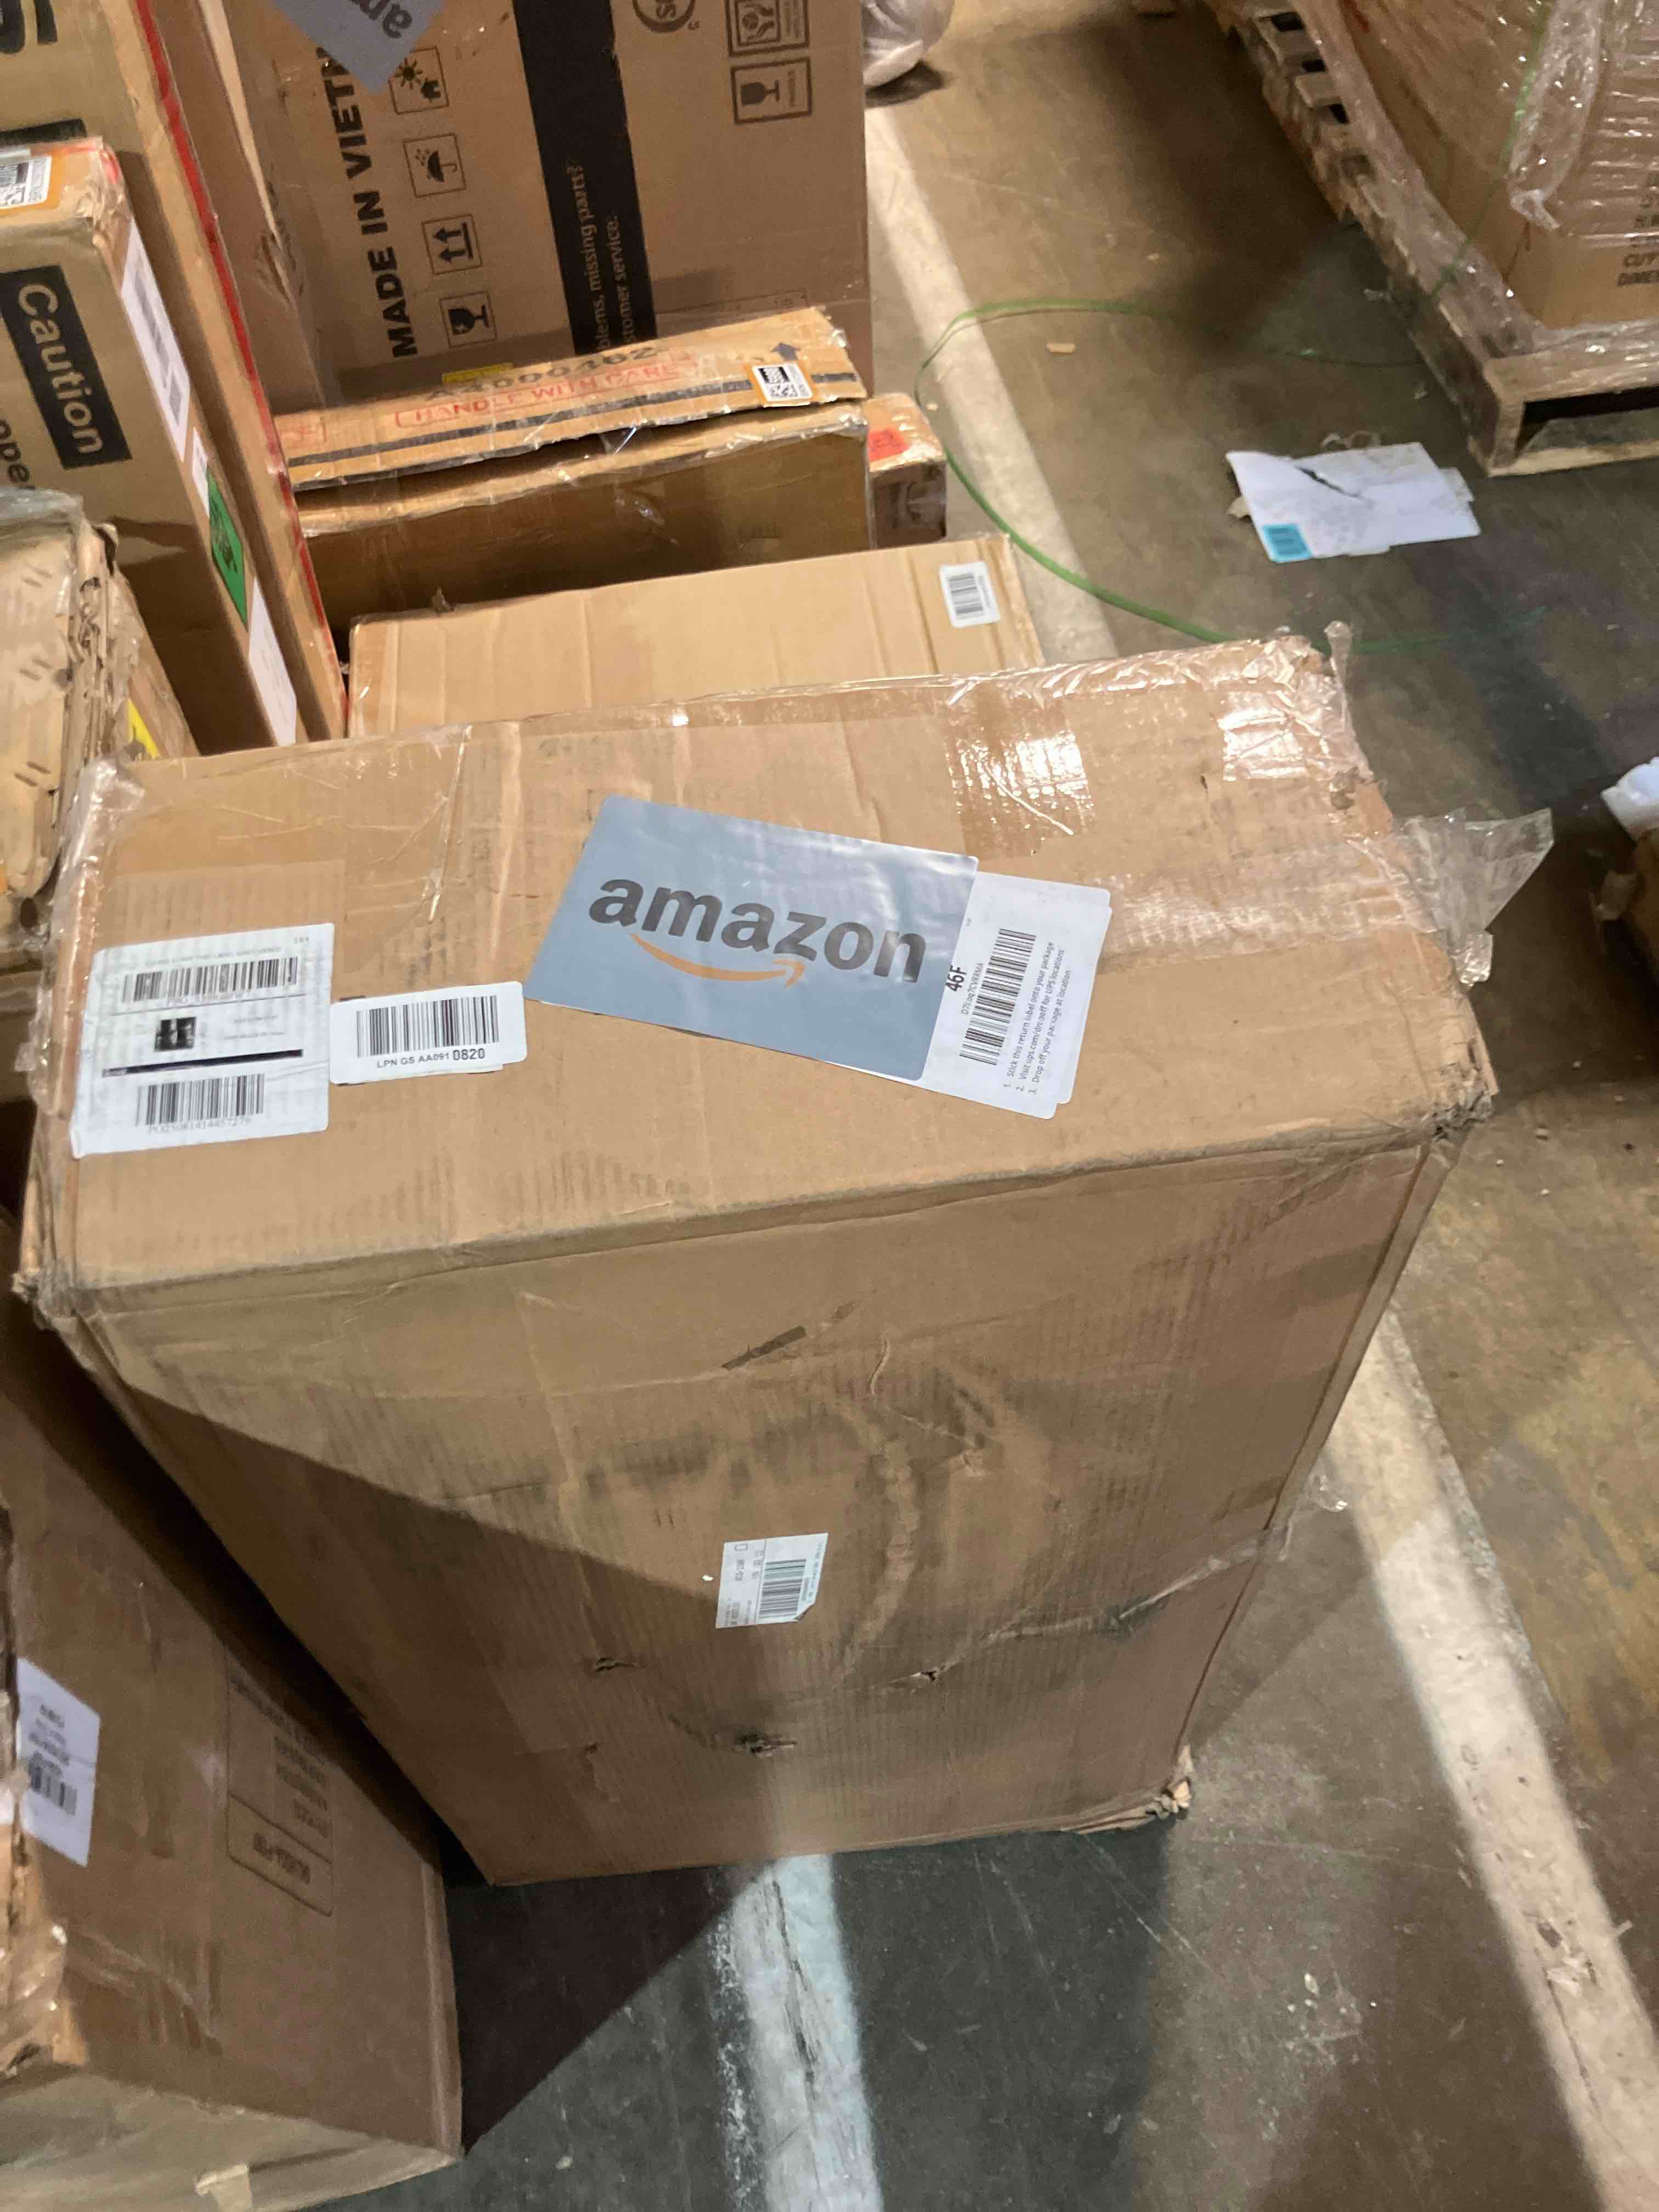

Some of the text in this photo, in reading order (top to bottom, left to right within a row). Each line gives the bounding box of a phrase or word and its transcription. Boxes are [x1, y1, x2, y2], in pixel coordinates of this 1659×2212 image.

[353, 190, 388, 235] IN
[580, 223, 603, 291] missing
[368, 246, 417, 358] MADE
[18, 283, 104, 454] Caution
[531, 378, 597, 400] WITH
[605, 364, 679, 383] CARE
[589, 878, 927, 984] amazon
[1042, 941, 1056, 970] package
[1051, 948, 1065, 980] locations
[945, 965, 967, 992] 46F
[1035, 969, 1047, 986] your
[1045, 979, 1056, 994] UPS
[1058, 969, 1072, 998] location
[1031, 986, 1041, 1003] onto
[1041, 995, 1051, 1006] for
[1054, 998, 1063, 1006] at
[1017, 1021, 1030, 1045] return
[1012, 1045, 1023, 1059] this
[1041, 1037, 1053, 1054] your
[377, 1059, 398, 1068] LPN
[400, 1057, 415, 1065] GS
[453, 1048, 486, 1061] 0820
[1007, 1059, 1018, 1077] Stick
[1036, 1053, 1047, 1065] off
[1019, 1063, 1031, 1080] Visit
[1031, 1064, 1045, 1084] Drop
